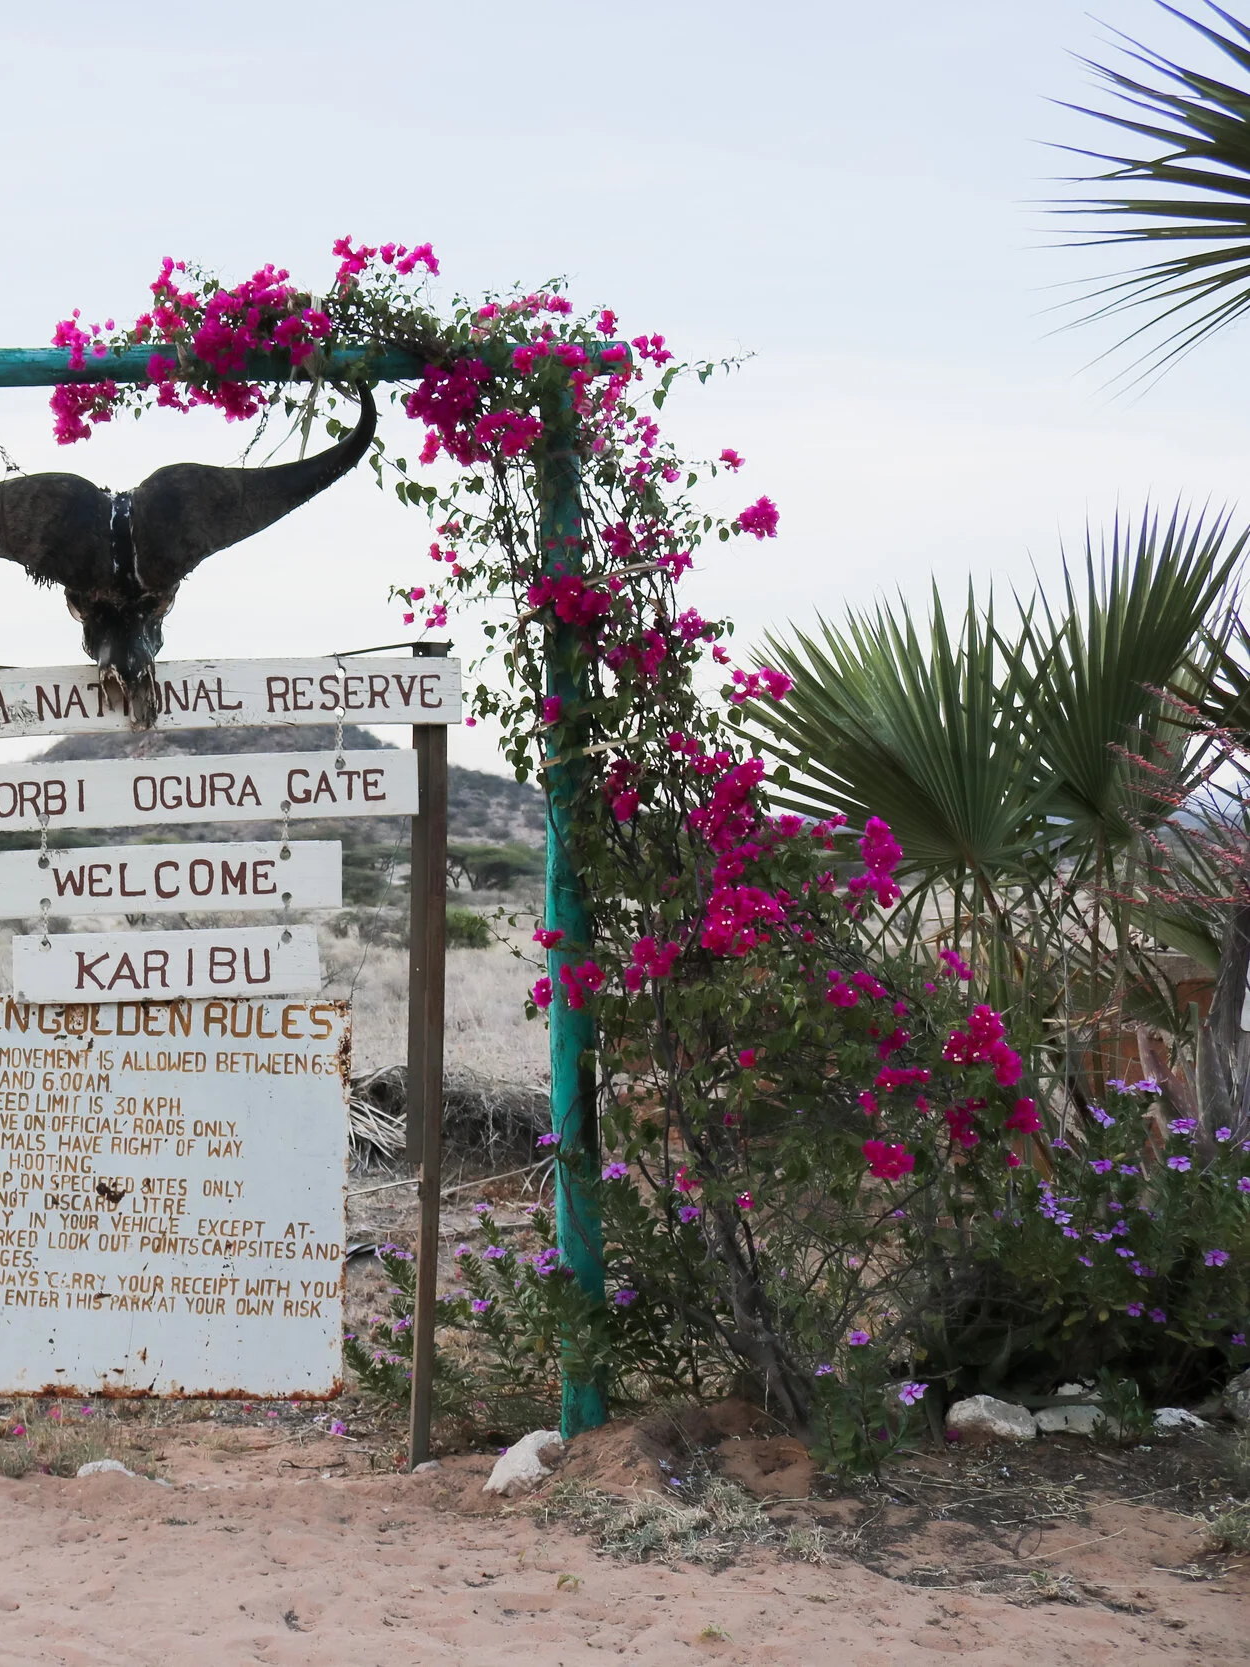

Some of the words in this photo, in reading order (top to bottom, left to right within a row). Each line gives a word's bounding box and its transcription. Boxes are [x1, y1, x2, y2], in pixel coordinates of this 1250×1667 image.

[266, 674, 443, 713] RESERVE
[133, 772, 262, 811] OGURA
[287, 768, 386, 804] GATE
[53, 859, 277, 899] WELCOME
[75, 946, 271, 990] KARIBU
[37, 1000, 193, 1038] GOLDEN
[203, 1001, 336, 1040] RULES
[99, 1049, 115, 1072] IS
[122, 1050, 207, 1074] ALLOWED
[215, 1051, 308, 1075] BETWEEN
[88, 1095, 103, 1115] IS
[113, 1096, 137, 1117] 30
[132, 1117, 186, 1137] ROADS
[58, 1133, 104, 1155] HAVE
[175, 1138, 197, 1158] OF
[20, 1172, 45, 1191] ON
[140, 1176, 188, 1197] SITES
[29, 1211, 47, 1230] IN
[59, 1212, 100, 1232] YOUR
[110, 1213, 180, 1236] VEHICLE
[197, 1218, 266, 1238] EXCEPT
[48, 1231, 91, 1251] LOOK
[98, 1232, 132, 1253] OUT
[117, 1273, 165, 1294] YOUR
[171, 1275, 240, 1296] RECEIPT
[245, 1278, 291, 1299] WITH
[4, 1288, 60, 1309] ENTER
[156, 1295, 176, 1313] AT
[185, 1296, 226, 1316] YOUR
[235, 1297, 275, 1317] OWN
